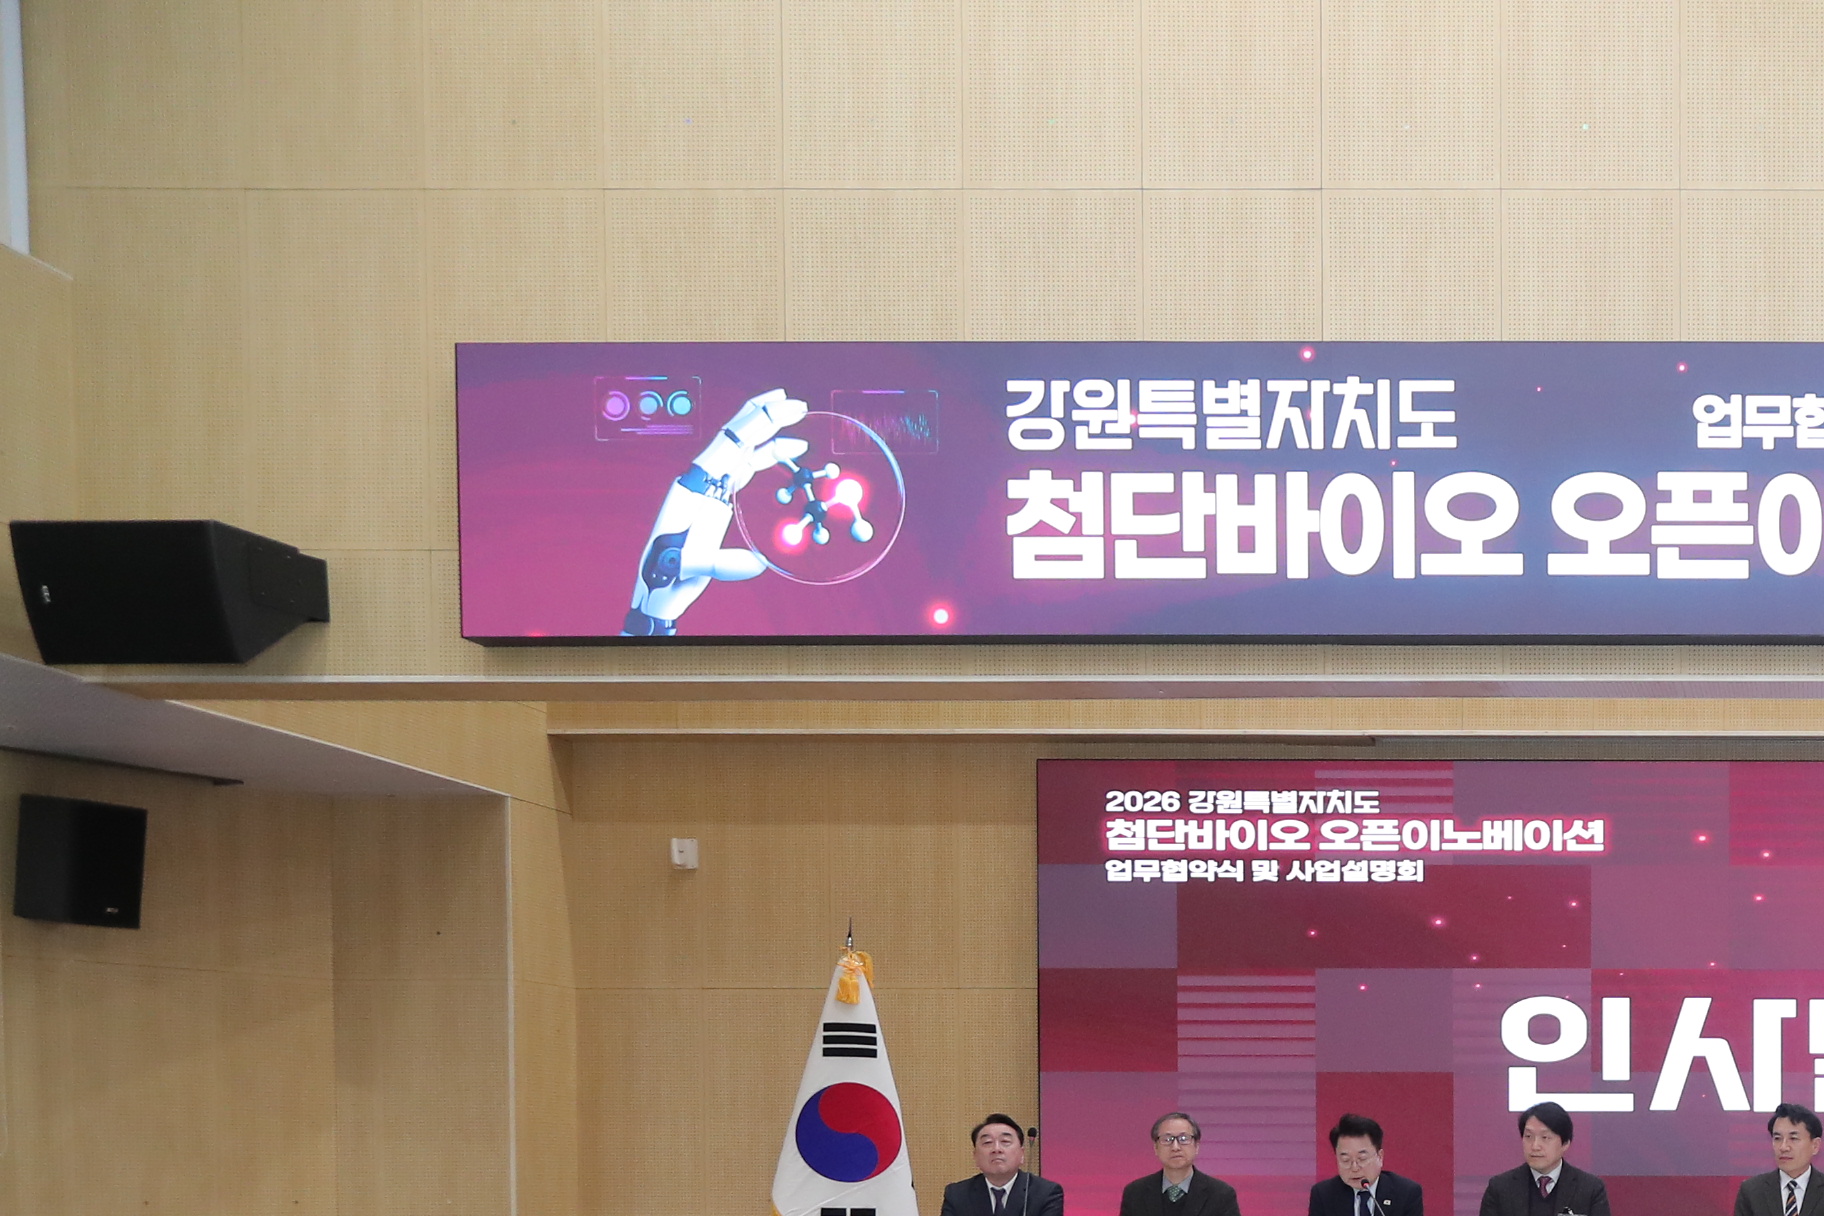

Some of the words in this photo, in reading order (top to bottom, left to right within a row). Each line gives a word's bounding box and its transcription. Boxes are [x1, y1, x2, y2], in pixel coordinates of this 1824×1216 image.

[1006, 376, 1457, 450] 강원특별자치도
[1007, 469, 1524, 579] 첨단바이오
[1106, 791, 1180, 812] 2026
[1188, 789, 1380, 814] 강원특별자치도
[1106, 818, 1311, 851] 첨단바이오
[1319, 819, 1604, 851] 오픈이노베이션
[1105, 859, 1244, 882] 업무협약식
[1252, 860, 1278, 882] 및
[1286, 859, 1424, 882] 사업설명회
